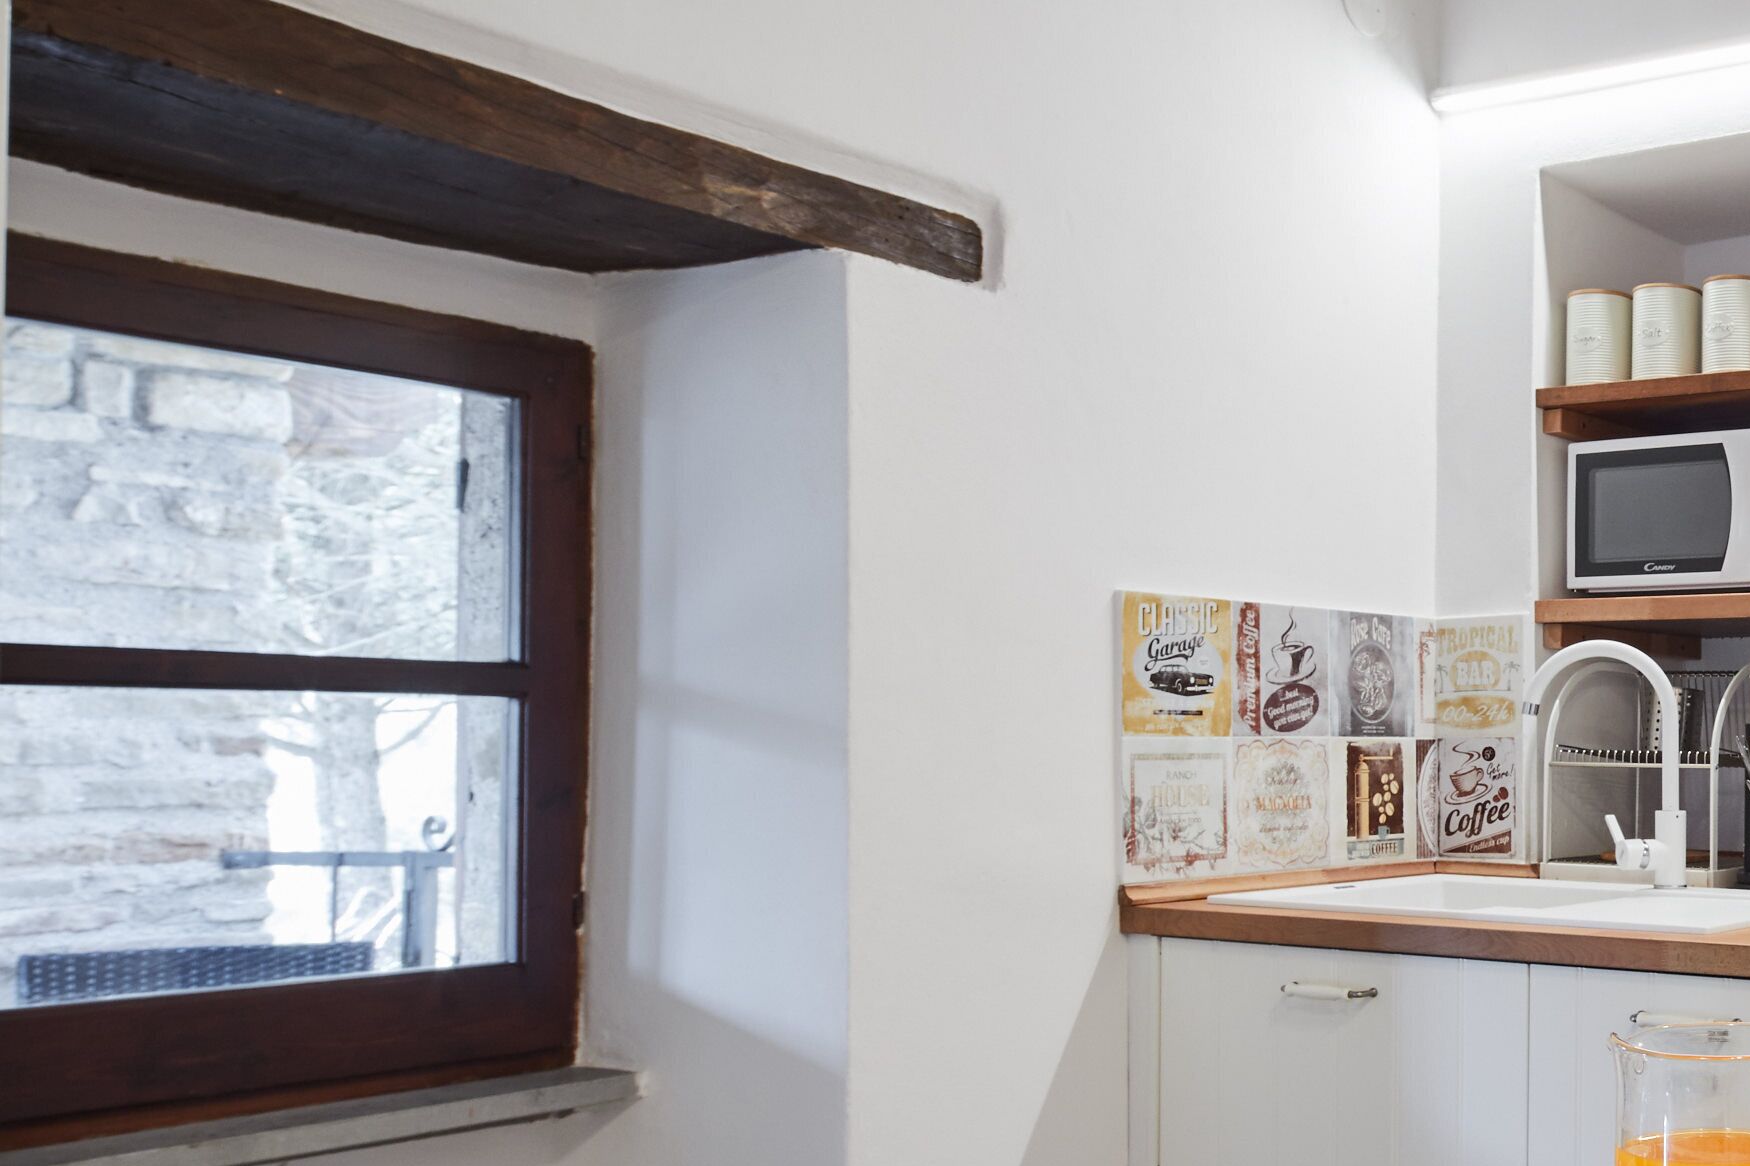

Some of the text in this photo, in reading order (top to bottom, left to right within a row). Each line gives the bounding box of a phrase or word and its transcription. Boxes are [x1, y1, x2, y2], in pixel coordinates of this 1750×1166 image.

[1642, 327, 1663, 339] Salt
[1138, 601, 1219, 637] CLASSIC
[1144, 636, 1205, 672] Garage
[1436, 625, 1519, 657] TROPICAL
[1242, 609, 1259, 727] Premium Coffee
[1456, 660, 1494, 686] BAR
[1486, 762, 1501, 778] Get
[1444, 800, 1511, 838] Coffee
[1371, 841, 1398, 856] COFFEE
